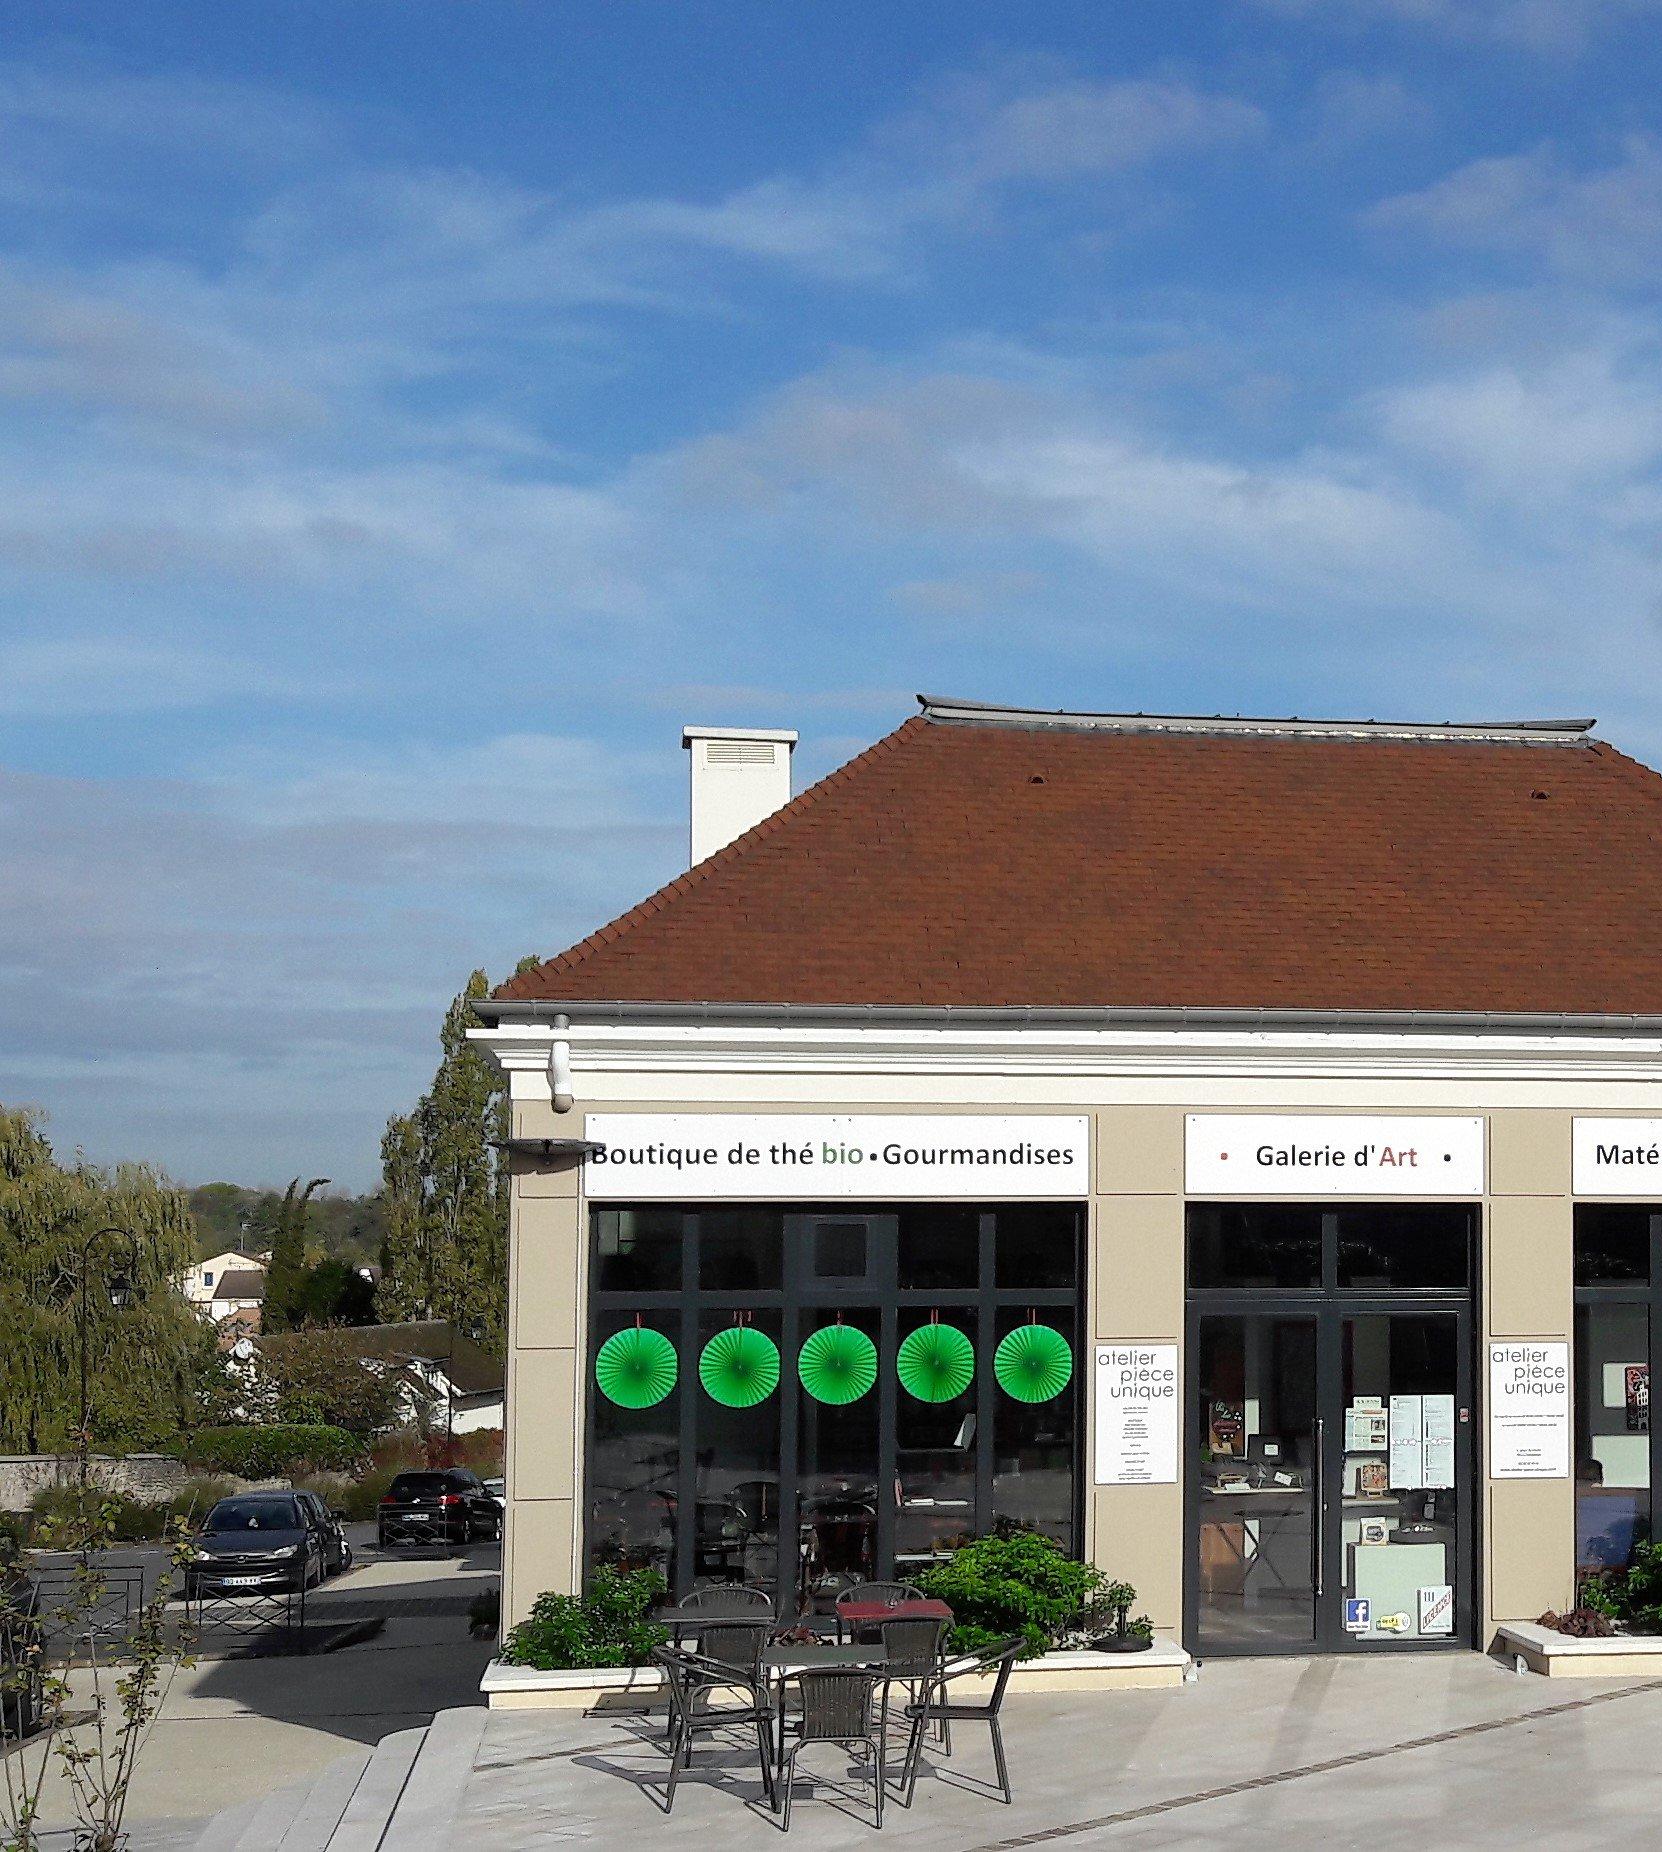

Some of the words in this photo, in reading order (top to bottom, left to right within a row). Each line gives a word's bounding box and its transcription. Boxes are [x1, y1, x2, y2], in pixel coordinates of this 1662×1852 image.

[592, 1142, 719, 1171] Boutique
[727, 1141, 761, 1166] de
[768, 1141, 814, 1166] thé
[822, 1141, 864, 1165] bio
[882, 1142, 1074, 1166] Gourmandises
[1256, 1143, 1346, 1167] Galerie
[1353, 1144, 1418, 1168] d'Art
[1098, 1350, 1157, 1366] atelier
[1492, 1348, 1549, 1363] atelier
[1120, 1366, 1174, 1385] pièce
[1514, 1363, 1566, 1381] pièce
[1110, 1383, 1175, 1401] unique
[1504, 1380, 1566, 1398] unique
